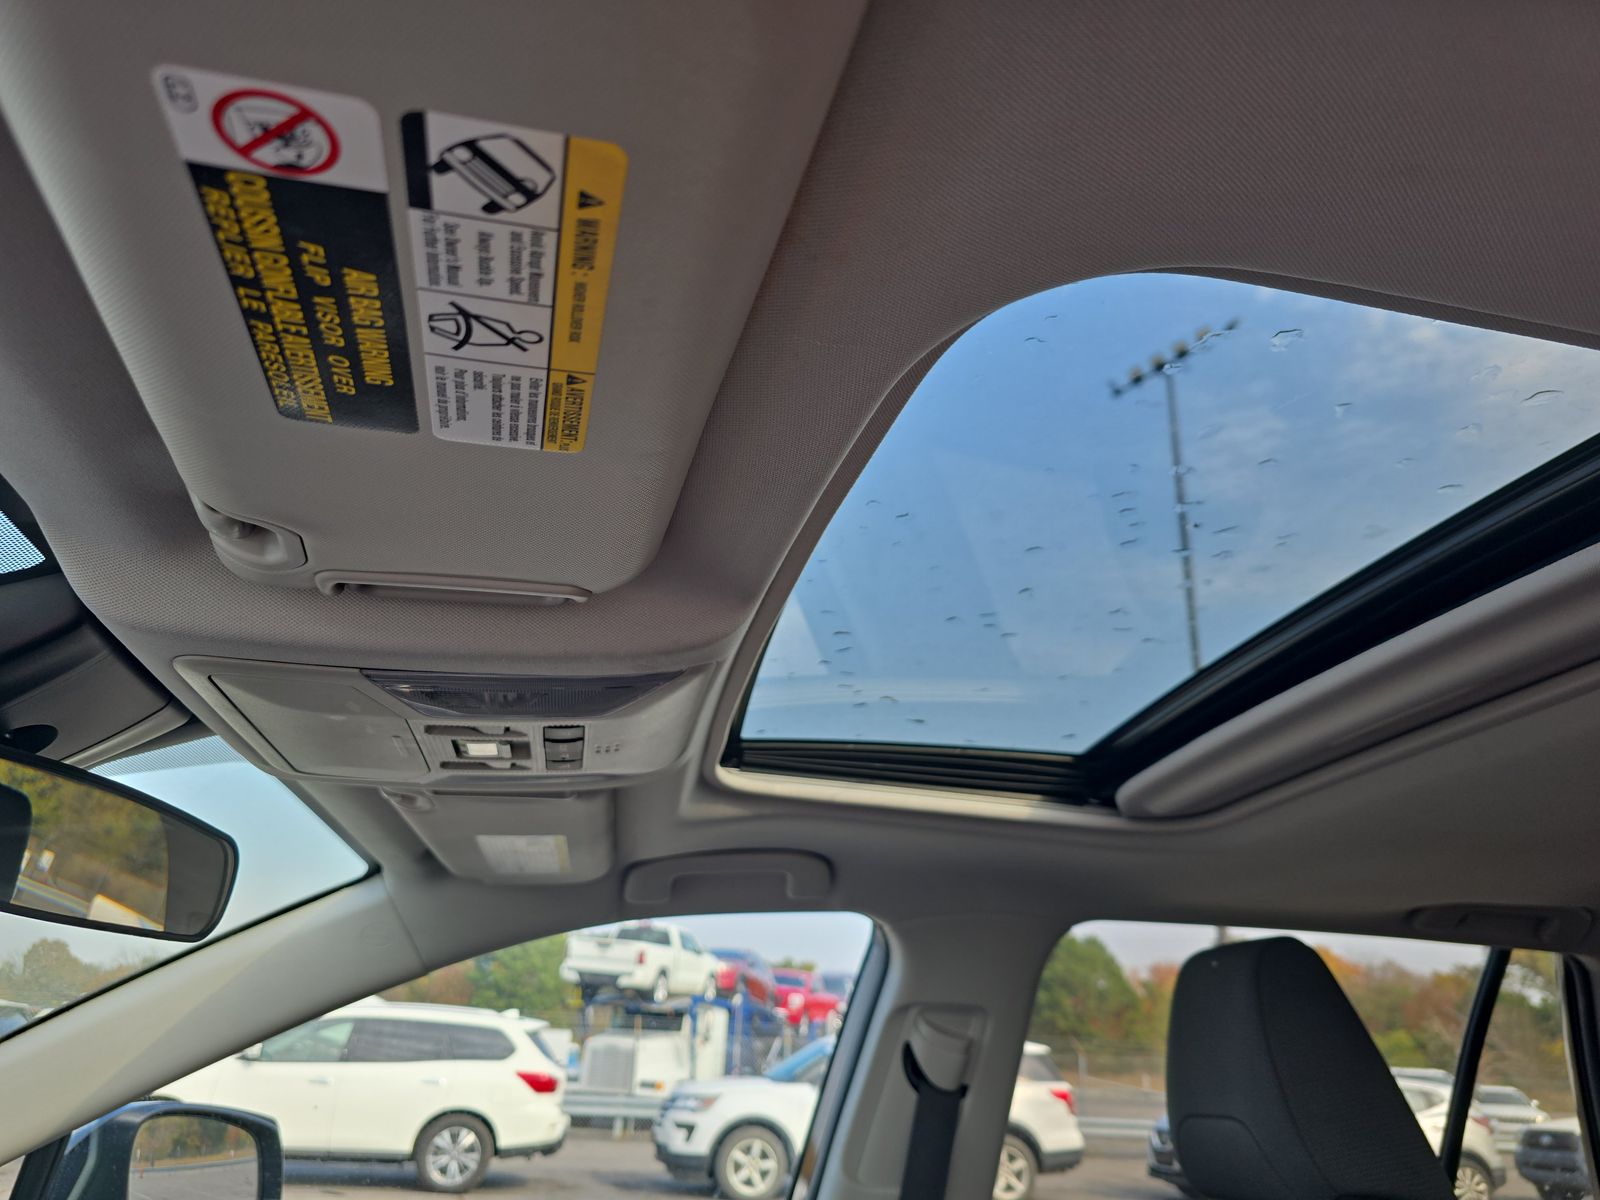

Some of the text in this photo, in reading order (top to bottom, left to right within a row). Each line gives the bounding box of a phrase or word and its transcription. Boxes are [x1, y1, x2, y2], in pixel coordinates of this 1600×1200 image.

[200, 185, 254, 279] REPLIER
[238, 287, 267, 313] LE
[297, 240, 355, 396] FLIP VISOR OVER
[254, 251, 307, 335] GONFLABLE
[281, 335, 333, 424] AVERTISSEMENT
[341, 267, 394, 386] AIR BAG WARNING
